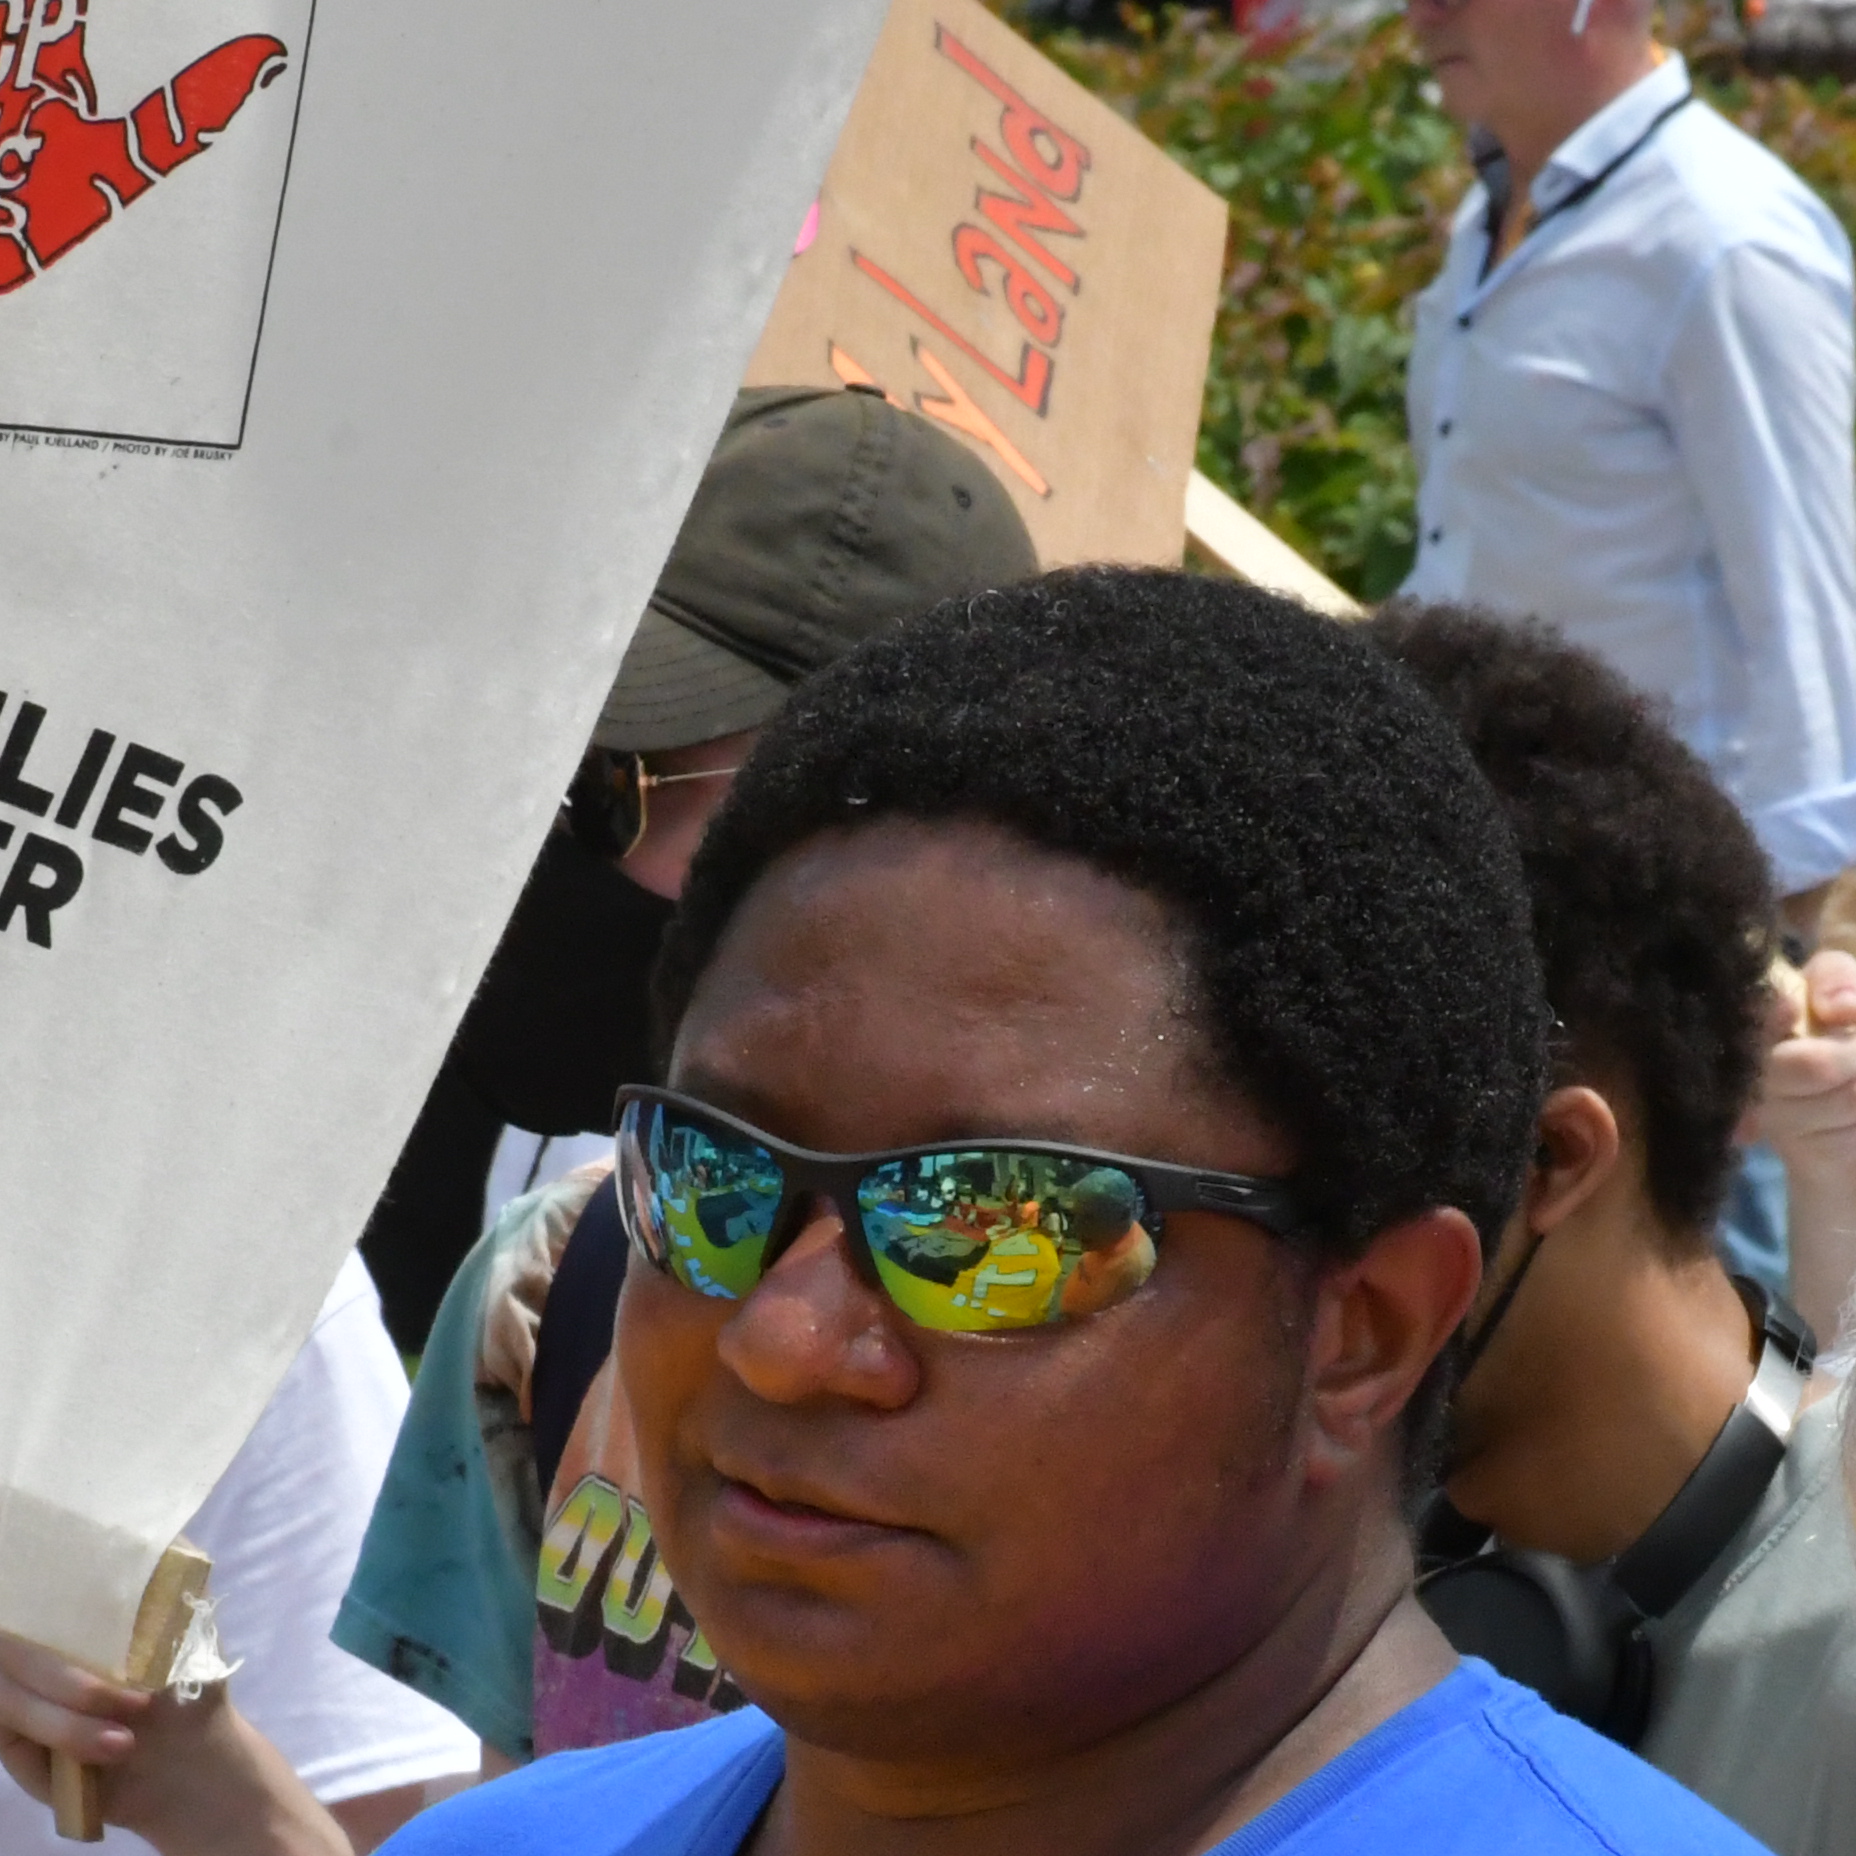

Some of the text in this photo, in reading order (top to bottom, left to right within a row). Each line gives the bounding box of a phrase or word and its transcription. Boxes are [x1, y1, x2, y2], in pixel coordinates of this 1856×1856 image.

[113, 441, 151, 456] PHOTO
[154, 445, 168, 457] BY
[171, 446, 190, 459] JOE
